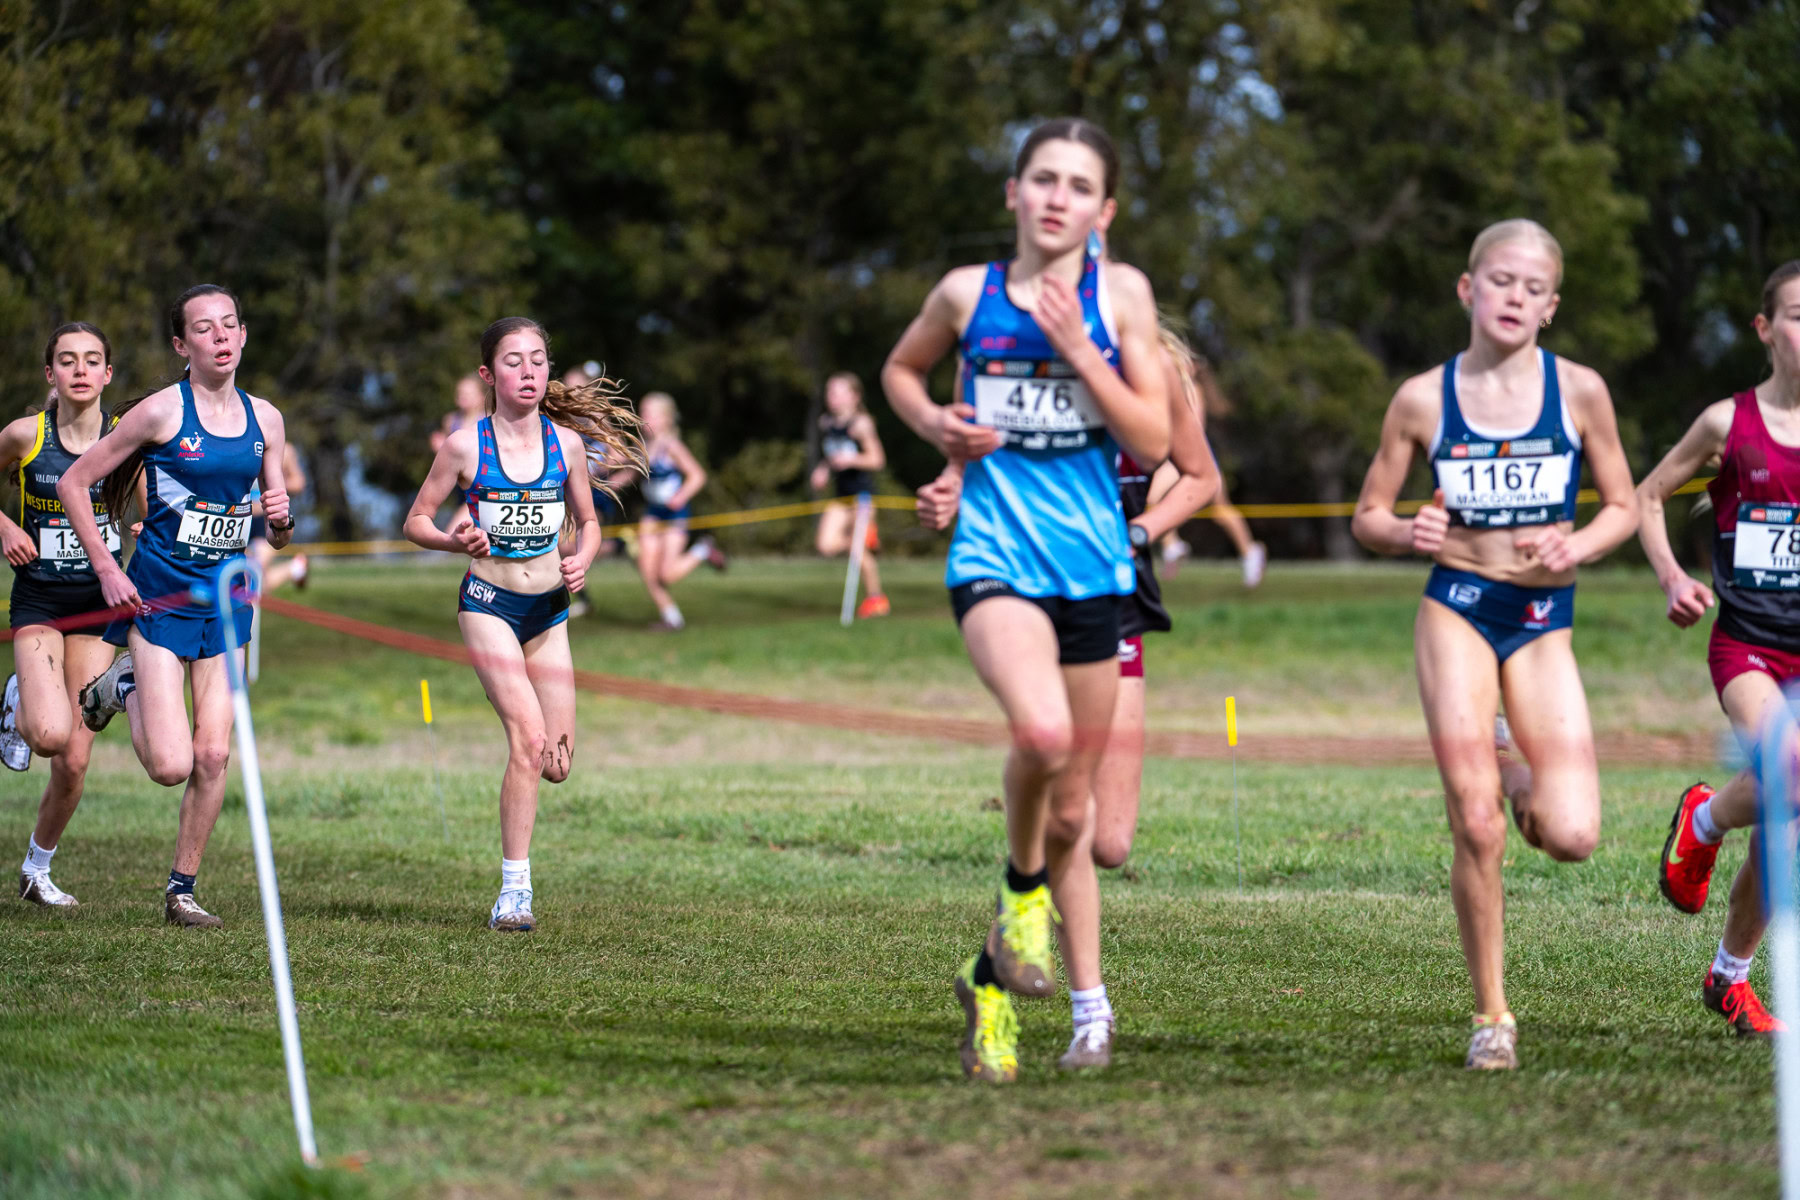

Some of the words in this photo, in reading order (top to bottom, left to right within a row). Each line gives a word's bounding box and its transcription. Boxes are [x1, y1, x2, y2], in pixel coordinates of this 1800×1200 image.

[1007, 383, 1072, 411] 476
[35, 473, 59, 484] VALOUR
[1463, 462, 1542, 491] 1167
[499, 505, 543, 525] 255
[199, 515, 245, 538] 1081
[491, 525, 551, 534] DZIUBINSKI
[56, 526, 109, 550] 134
[188, 534, 245, 547] HAASBROEK
[1768, 529, 1800, 554] 78
[467, 581, 496, 603] NSW
